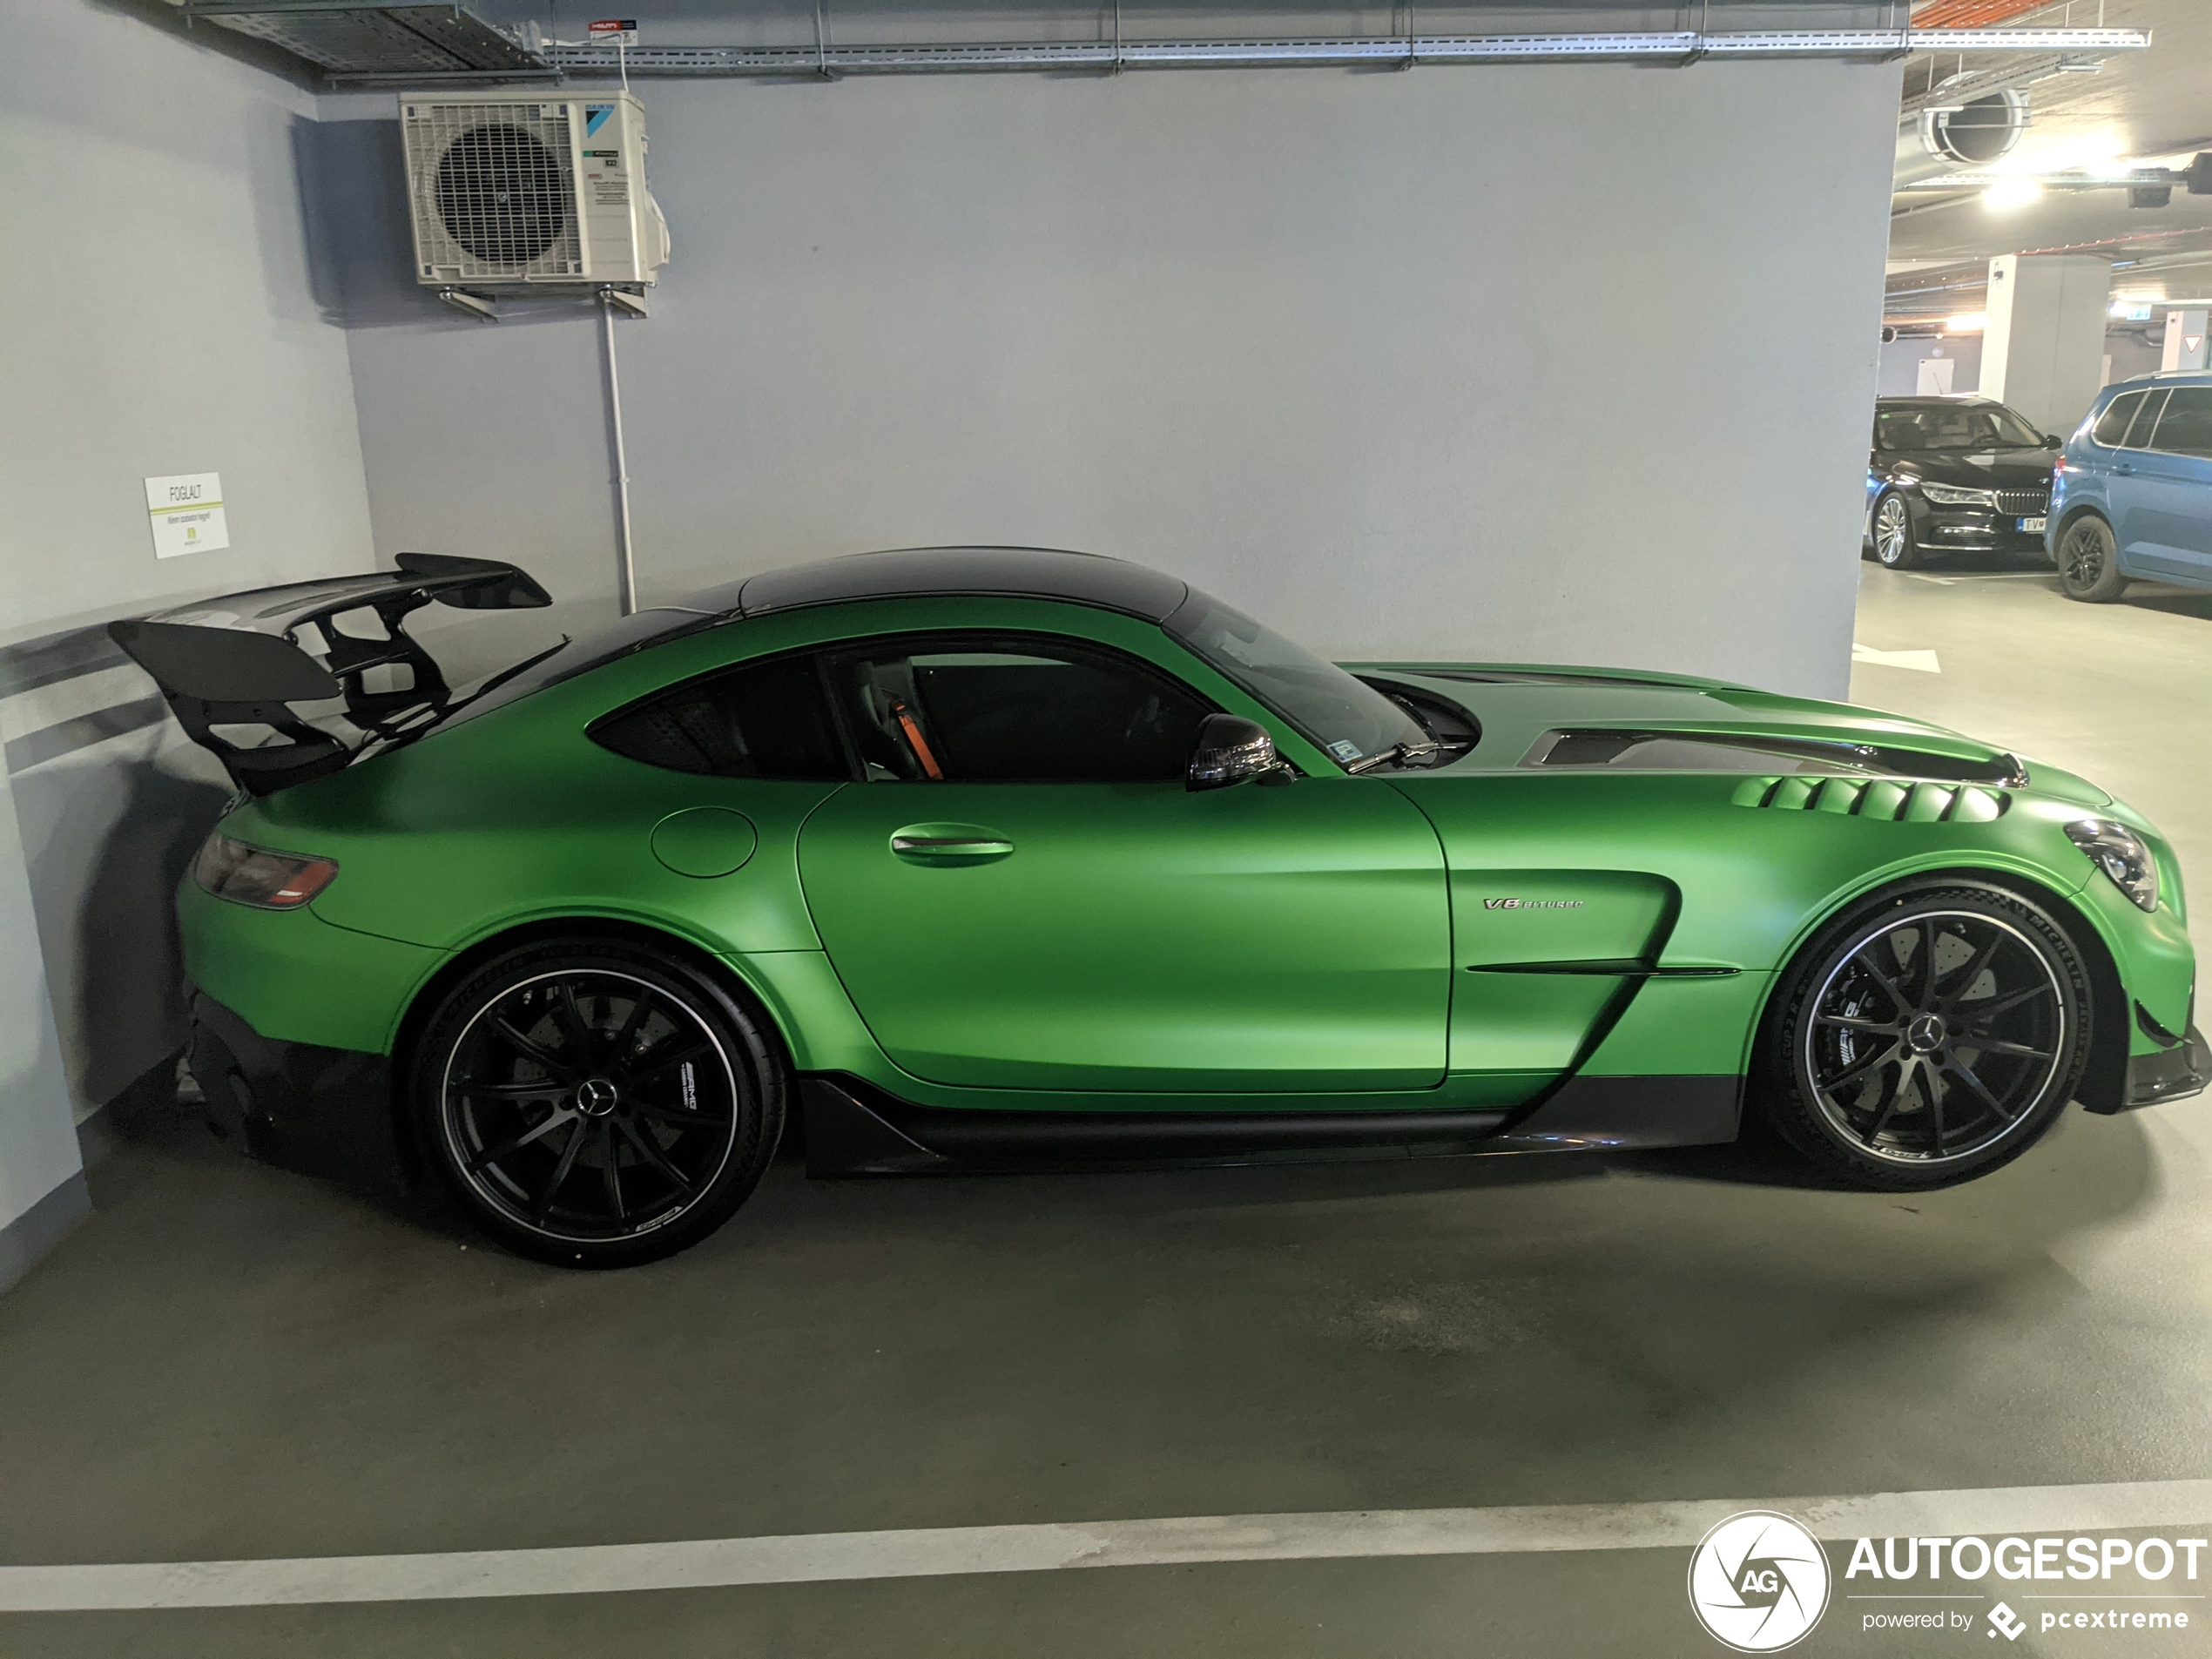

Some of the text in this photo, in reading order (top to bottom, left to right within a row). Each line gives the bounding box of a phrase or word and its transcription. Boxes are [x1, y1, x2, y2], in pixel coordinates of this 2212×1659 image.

[169, 484, 201, 502] FOGLALT
[1483, 898, 1520, 909] V8
[2030, 914, 2085, 990] MICHELIN
